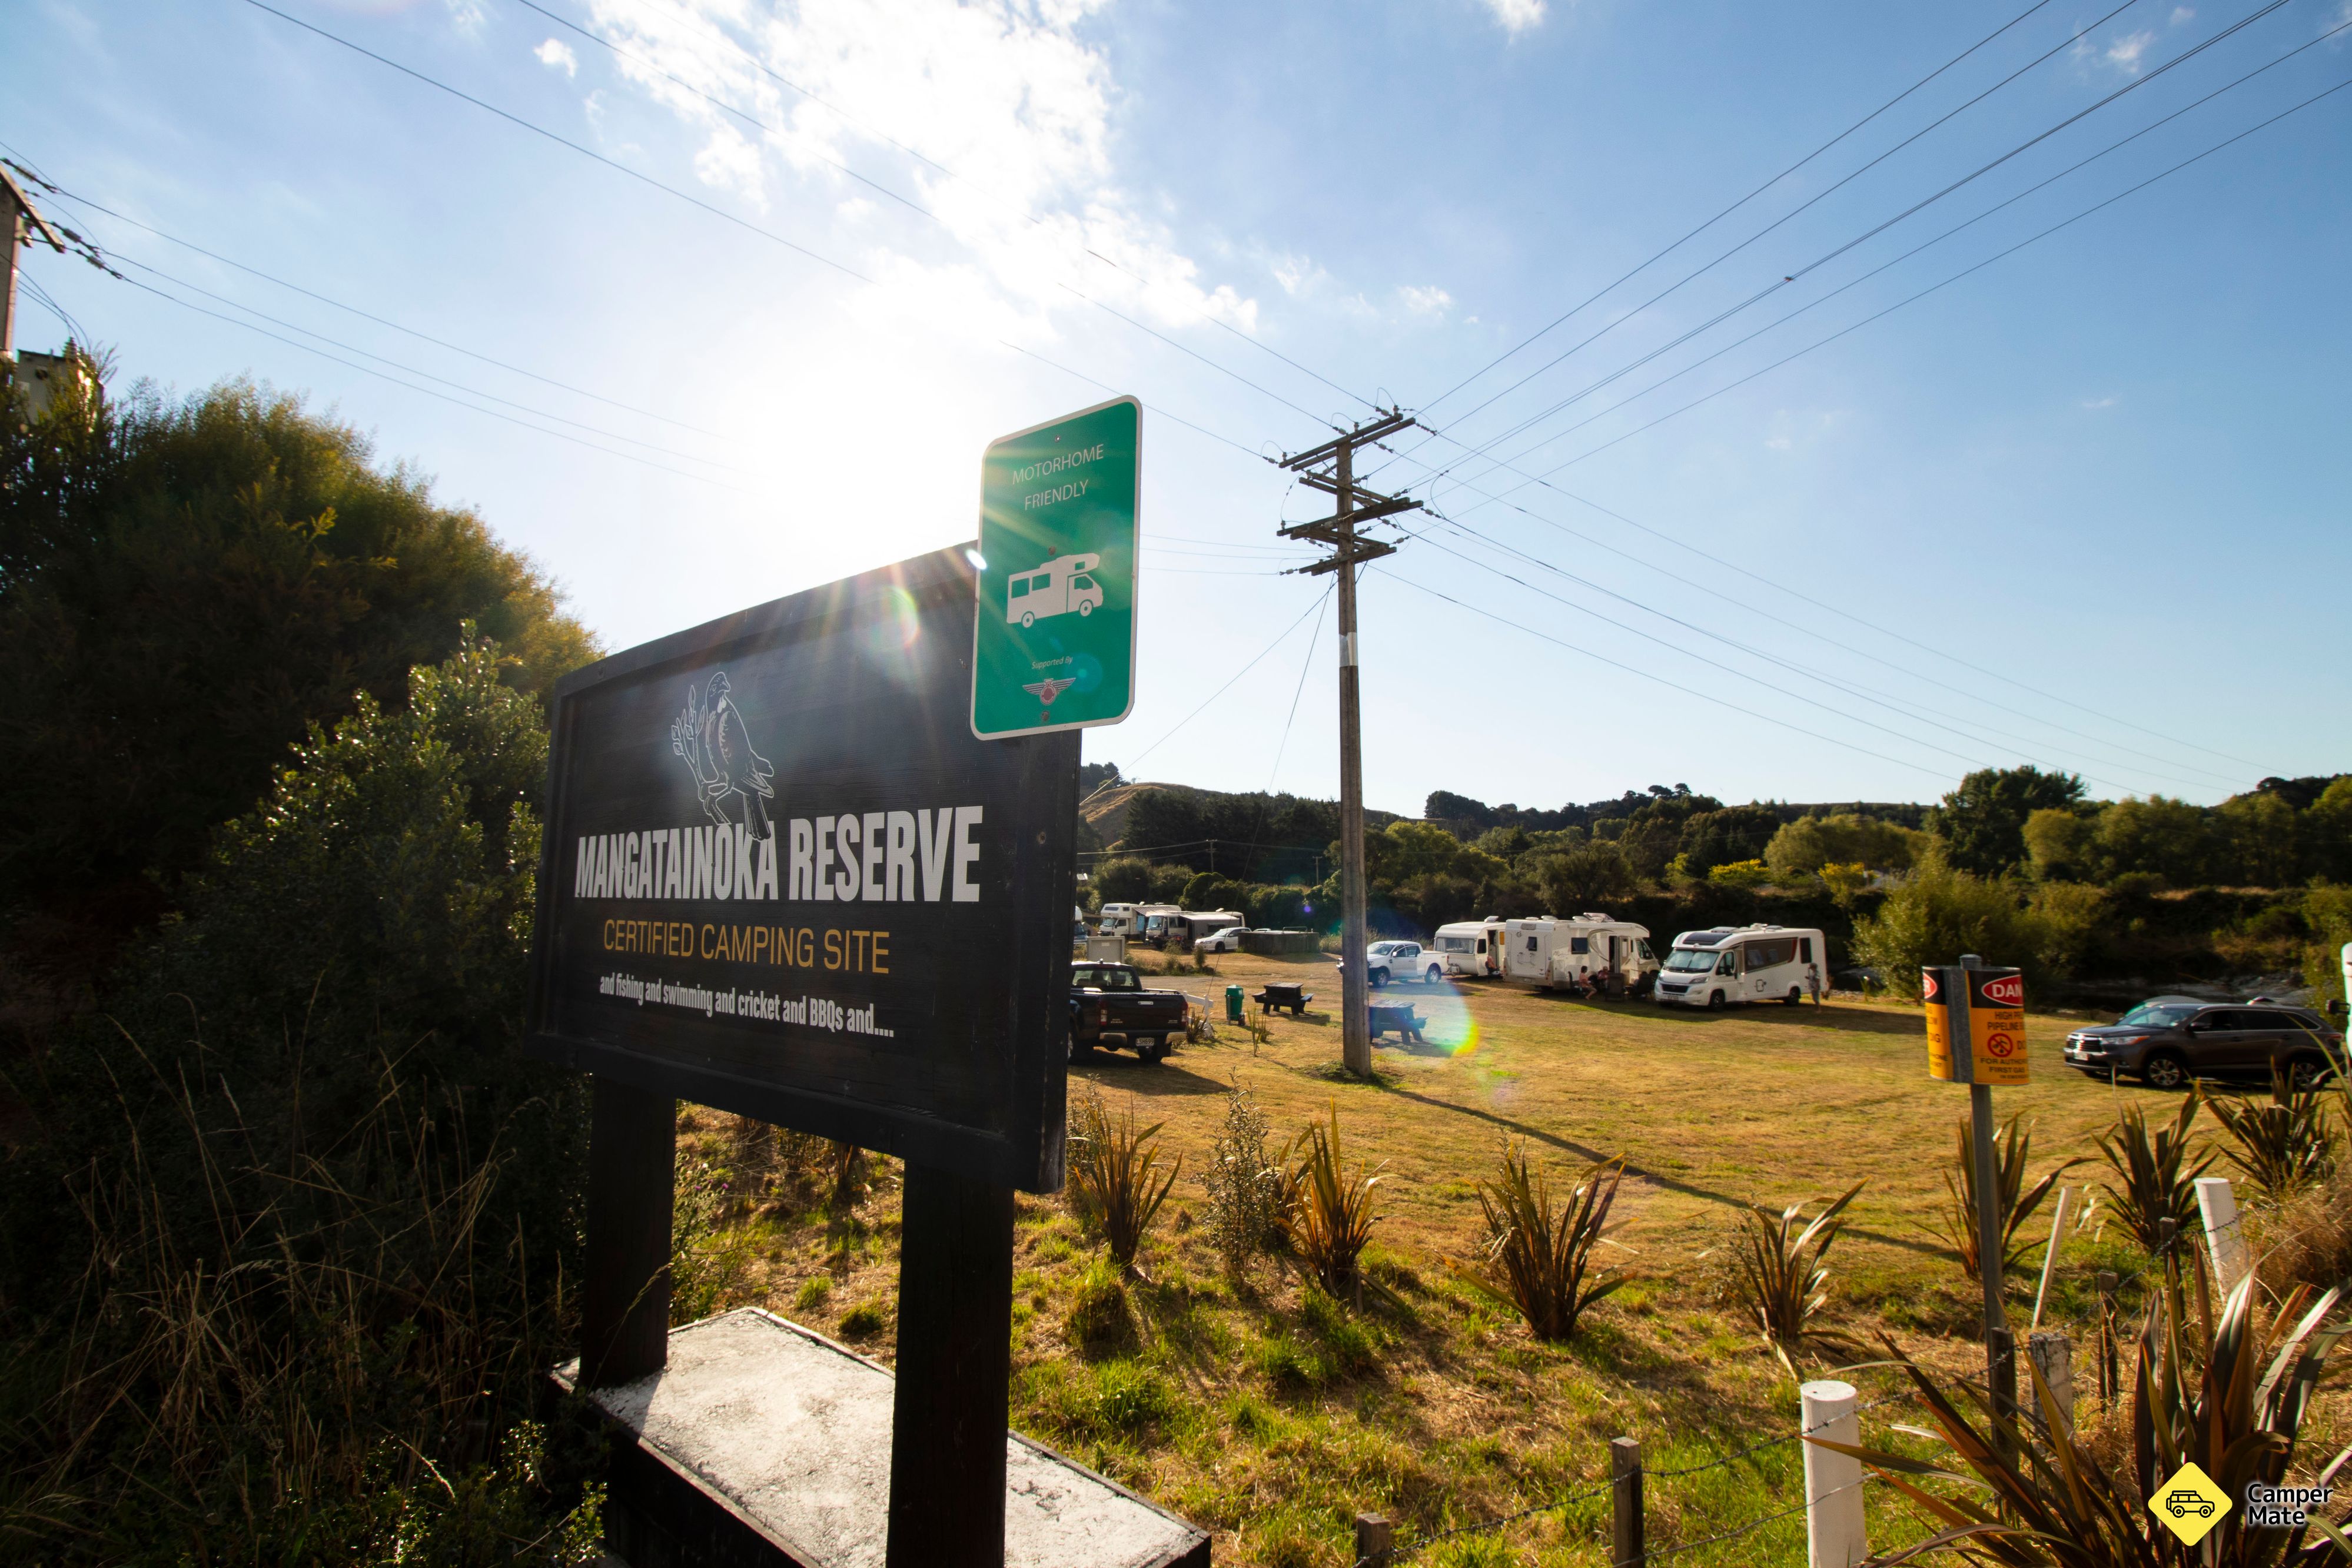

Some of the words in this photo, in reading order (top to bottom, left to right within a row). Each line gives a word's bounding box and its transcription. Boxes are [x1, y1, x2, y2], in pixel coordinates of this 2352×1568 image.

[1013, 444, 1104, 485] MOTORHOME
[1025, 480, 1089, 511] FRIENDLY
[1031, 656, 1064, 669] Supported
[1065, 656, 1073, 665] By
[575, 821, 779, 900] MANGATAINOKA
[789, 806, 984, 902] RESERVE
[604, 919, 694, 957] CERTIFIED
[700, 924, 813, 968] CAMPING
[824, 929, 890, 974] SITE
[600, 972, 614, 995] and
[616, 973, 643, 1005] fishing
[646, 978, 661, 1002] and
[663, 981, 713, 1017] swimming
[715, 987, 735, 1014] and
[738, 990, 780, 1021] cricket
[783, 996, 806, 1025] and
[810, 999, 843, 1033] BBQs
[1988, 1022, 2019, 1031] PIPELINE
